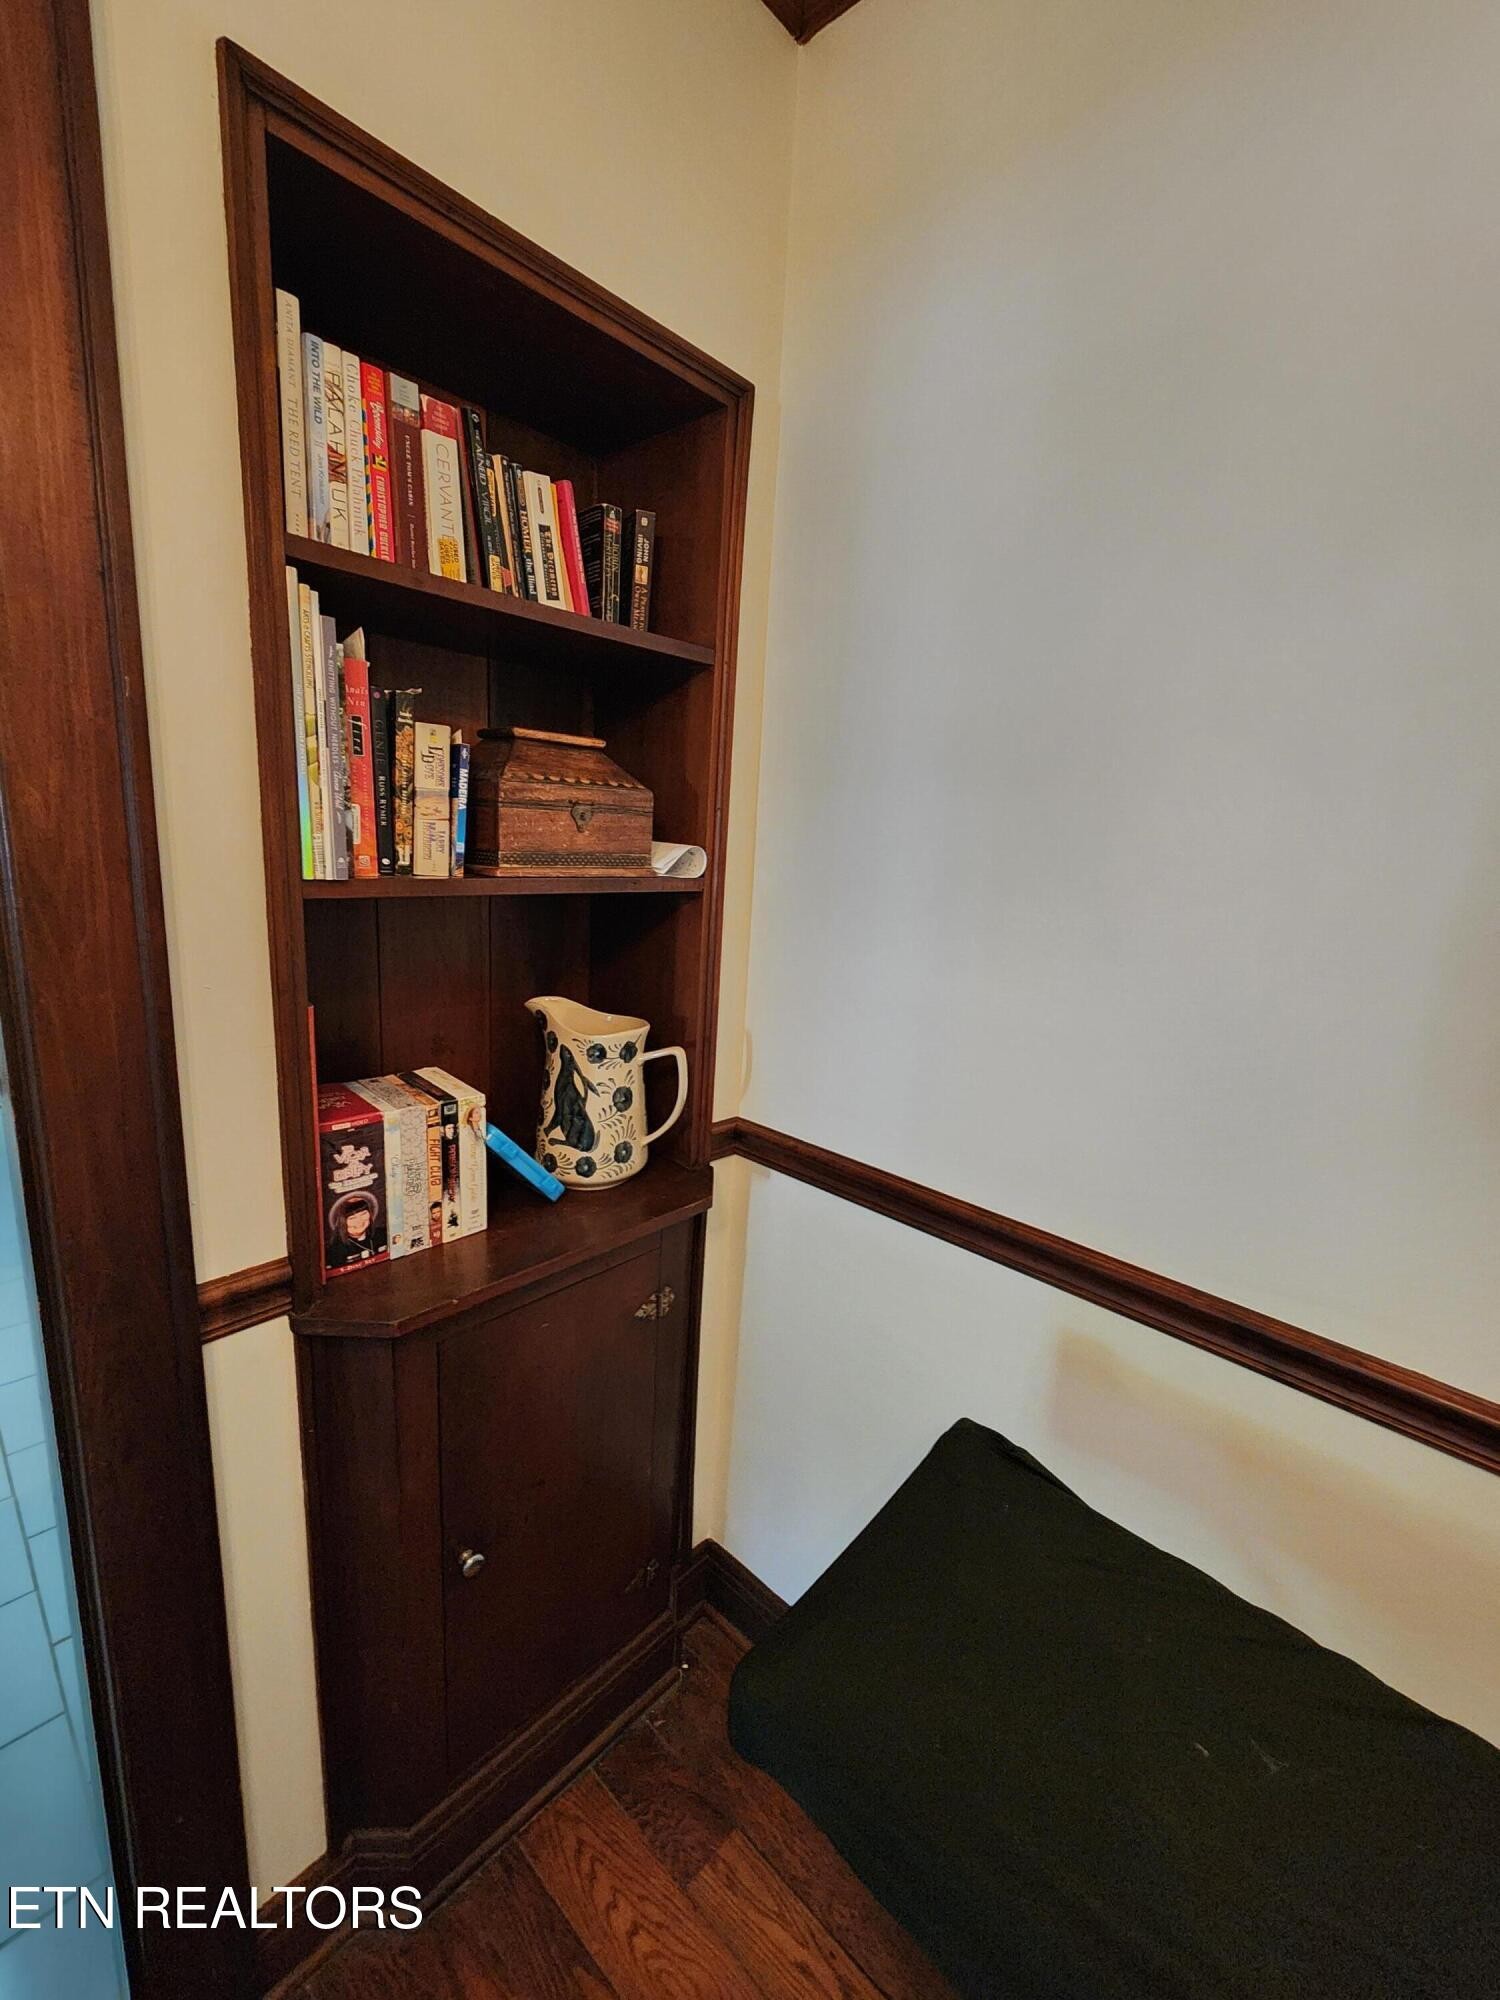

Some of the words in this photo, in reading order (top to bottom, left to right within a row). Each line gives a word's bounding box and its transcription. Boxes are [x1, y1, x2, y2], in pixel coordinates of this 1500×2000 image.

[311, 341, 320, 368] INTO
[312, 373, 321, 394] THE
[346, 363, 361, 412] Choke
[288, 399, 300, 426] THE
[313, 398, 323, 425] WILD
[288, 429, 301, 457] RED
[349, 420, 363, 462] Chuck
[289, 461, 302, 498] TENT
[351, 467, 367, 537] Palahniuk
[375, 475, 389, 530] CHRISTOPHER
[518, 510, 533, 554] HOMER
[636, 534, 644, 564] IRVING
[642, 538, 650, 562] JOHN
[525, 556, 534, 573] the
[528, 573, 537, 595] Iliad
[327, 660, 336, 694] KNITTING
[328, 697, 338, 731] WITHOUT
[331, 732, 340, 764] NEEDLES
[378, 775, 387, 797] RUSS
[458, 768, 469, 810] MADEIRA
[379, 799, 388, 826] RYMER
[429, 1138, 441, 1163] FIGHT
[430, 1166, 442, 1187] CLUB
